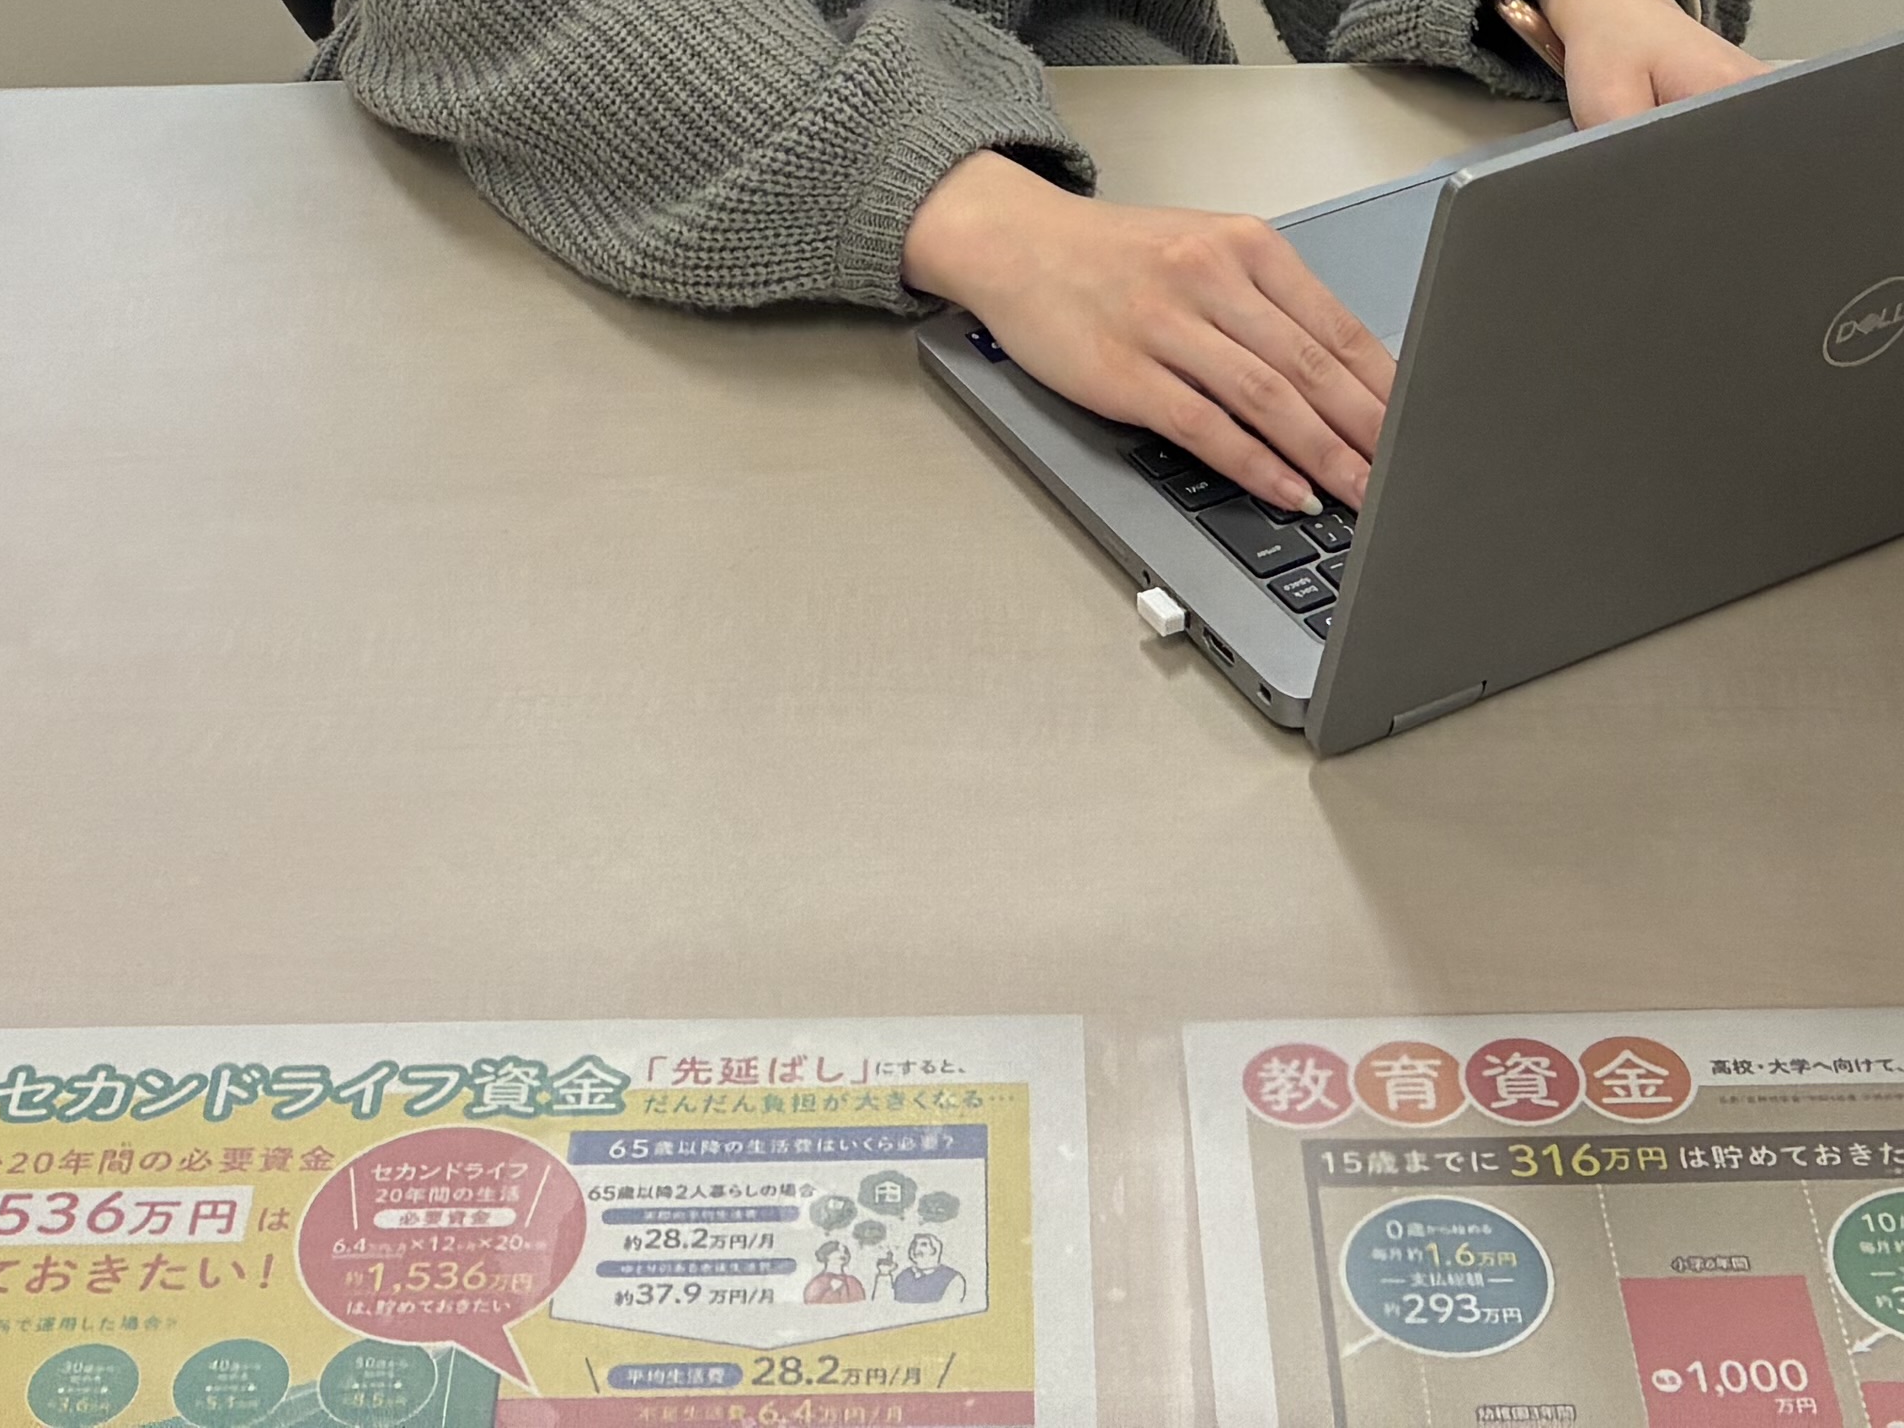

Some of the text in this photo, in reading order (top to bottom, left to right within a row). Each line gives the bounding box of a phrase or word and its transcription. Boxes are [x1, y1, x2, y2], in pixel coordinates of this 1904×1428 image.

[1256, 1046, 1673, 1111] 教育資金
[371, 1161, 529, 1183] セカンドライフ
[374, 1185, 521, 1204] 20年間の生活
[623, 1227, 775, 1251] 約28.2万円/月
[750, 1355, 923, 1388] 28.2万円/月
[1686, 1358, 1809, 1398] 1,000
[1774, 1396, 1818, 1415] 万円
